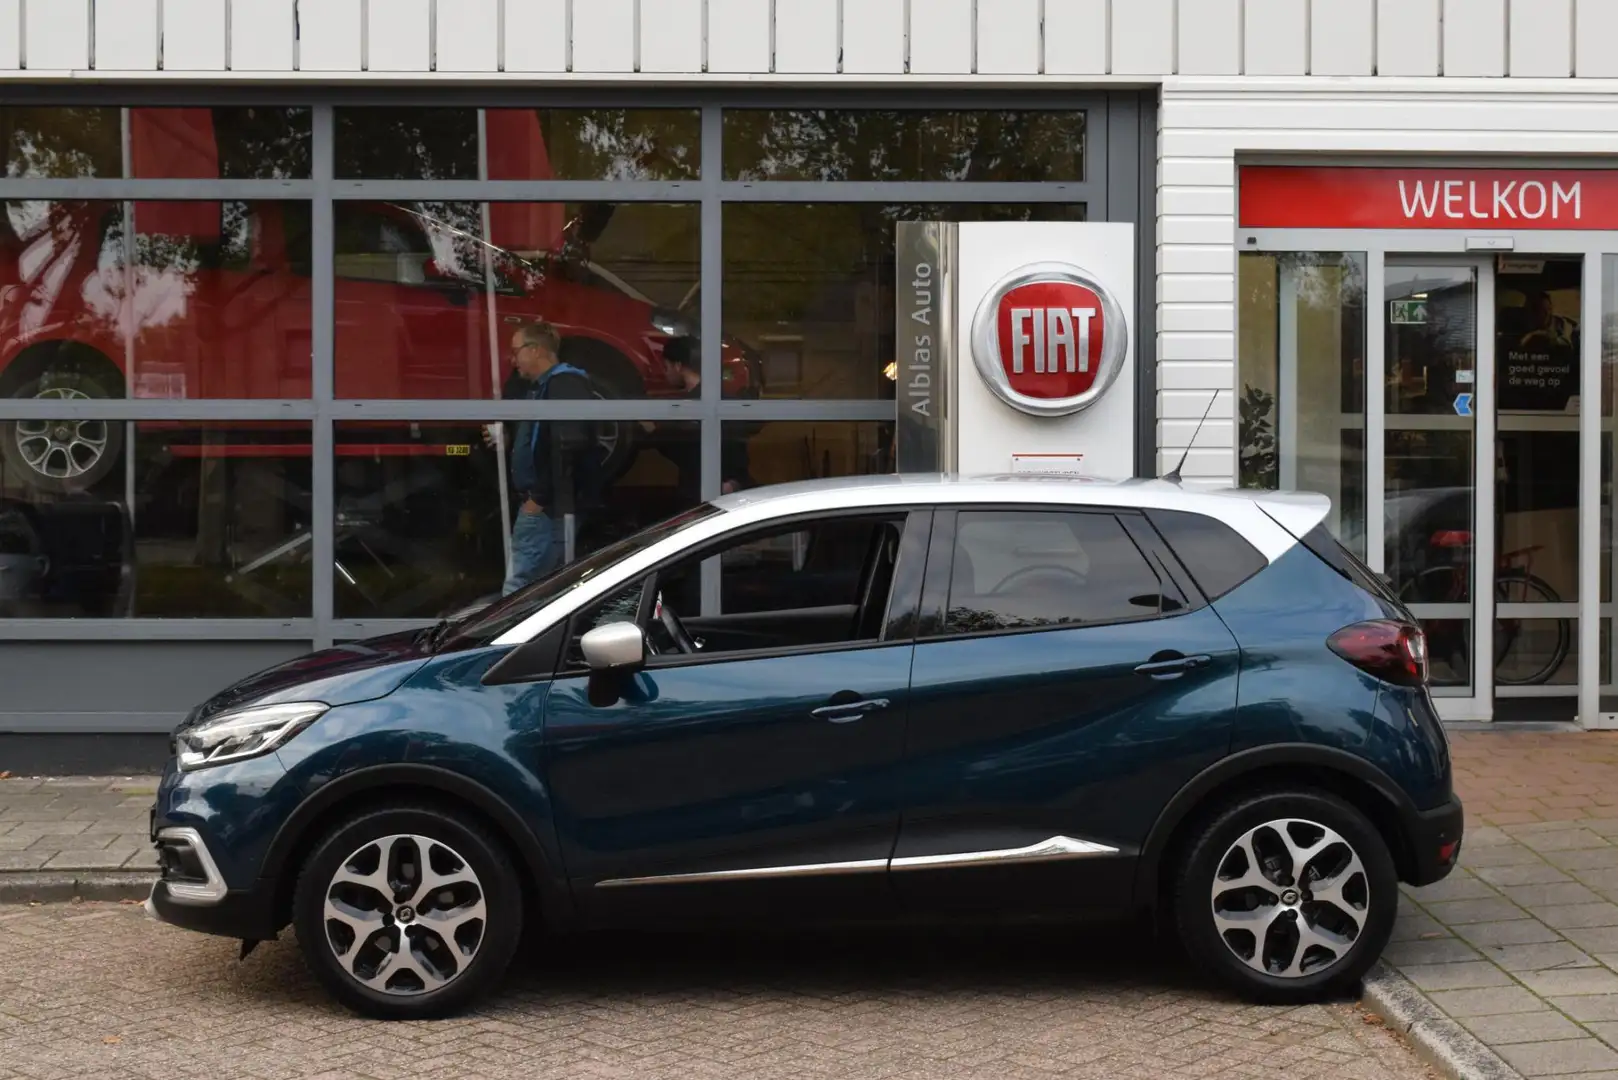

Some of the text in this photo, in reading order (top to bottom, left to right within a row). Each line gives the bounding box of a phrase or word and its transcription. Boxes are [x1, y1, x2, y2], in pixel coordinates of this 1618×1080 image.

[1398, 179, 1582, 219] WELKOM
[908, 262, 932, 417] Alblas Auto
[1011, 307, 1096, 373] FIAT
[1508, 351, 1528, 360] Met
[1508, 364, 1535, 375] goed
[1508, 376, 1522, 385] de
[1524, 378, 1546, 387] weg
